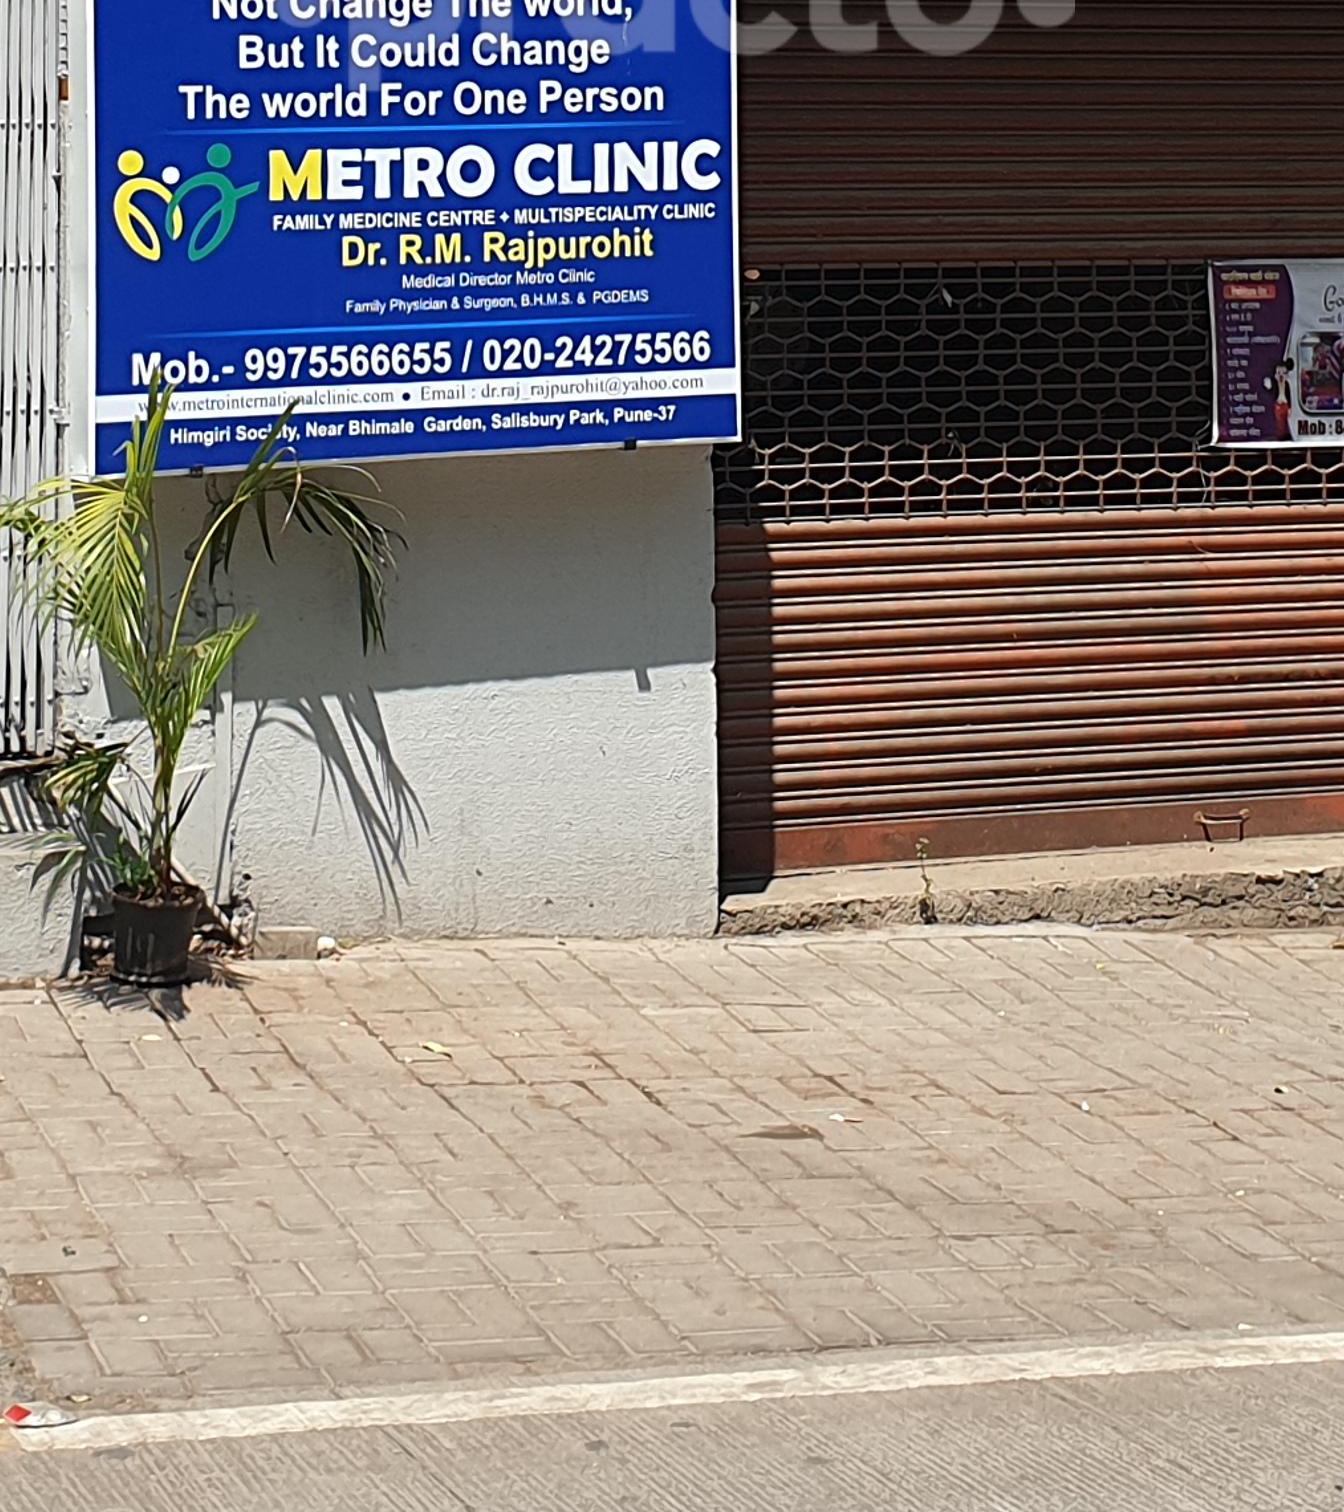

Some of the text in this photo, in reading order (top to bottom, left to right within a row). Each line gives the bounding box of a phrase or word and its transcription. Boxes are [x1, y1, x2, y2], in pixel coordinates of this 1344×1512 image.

[239, 32, 610, 73] But It Could Change
[179, 80, 663, 119] The world For One Person
[269, 139, 720, 201] METRO CLINIC
[273, 203, 715, 230] FAMILY MEDICINE CENTRE MULTISPECIALITY CLINIC
[342, 227, 653, 268] Dr. R.M. Rajpurohit
[245, 342, 451, 381] 9975566655
[482, 331, 712, 373] 020-24275566
[137, 388, 394, 413] ww.metrointernationalclinic.com
[171, 405, 675, 446] Himgiri Socty, Near Bhimale Garden, Salisbury Park, Pune-37
[1298, 420, 1326, 435] Mob
